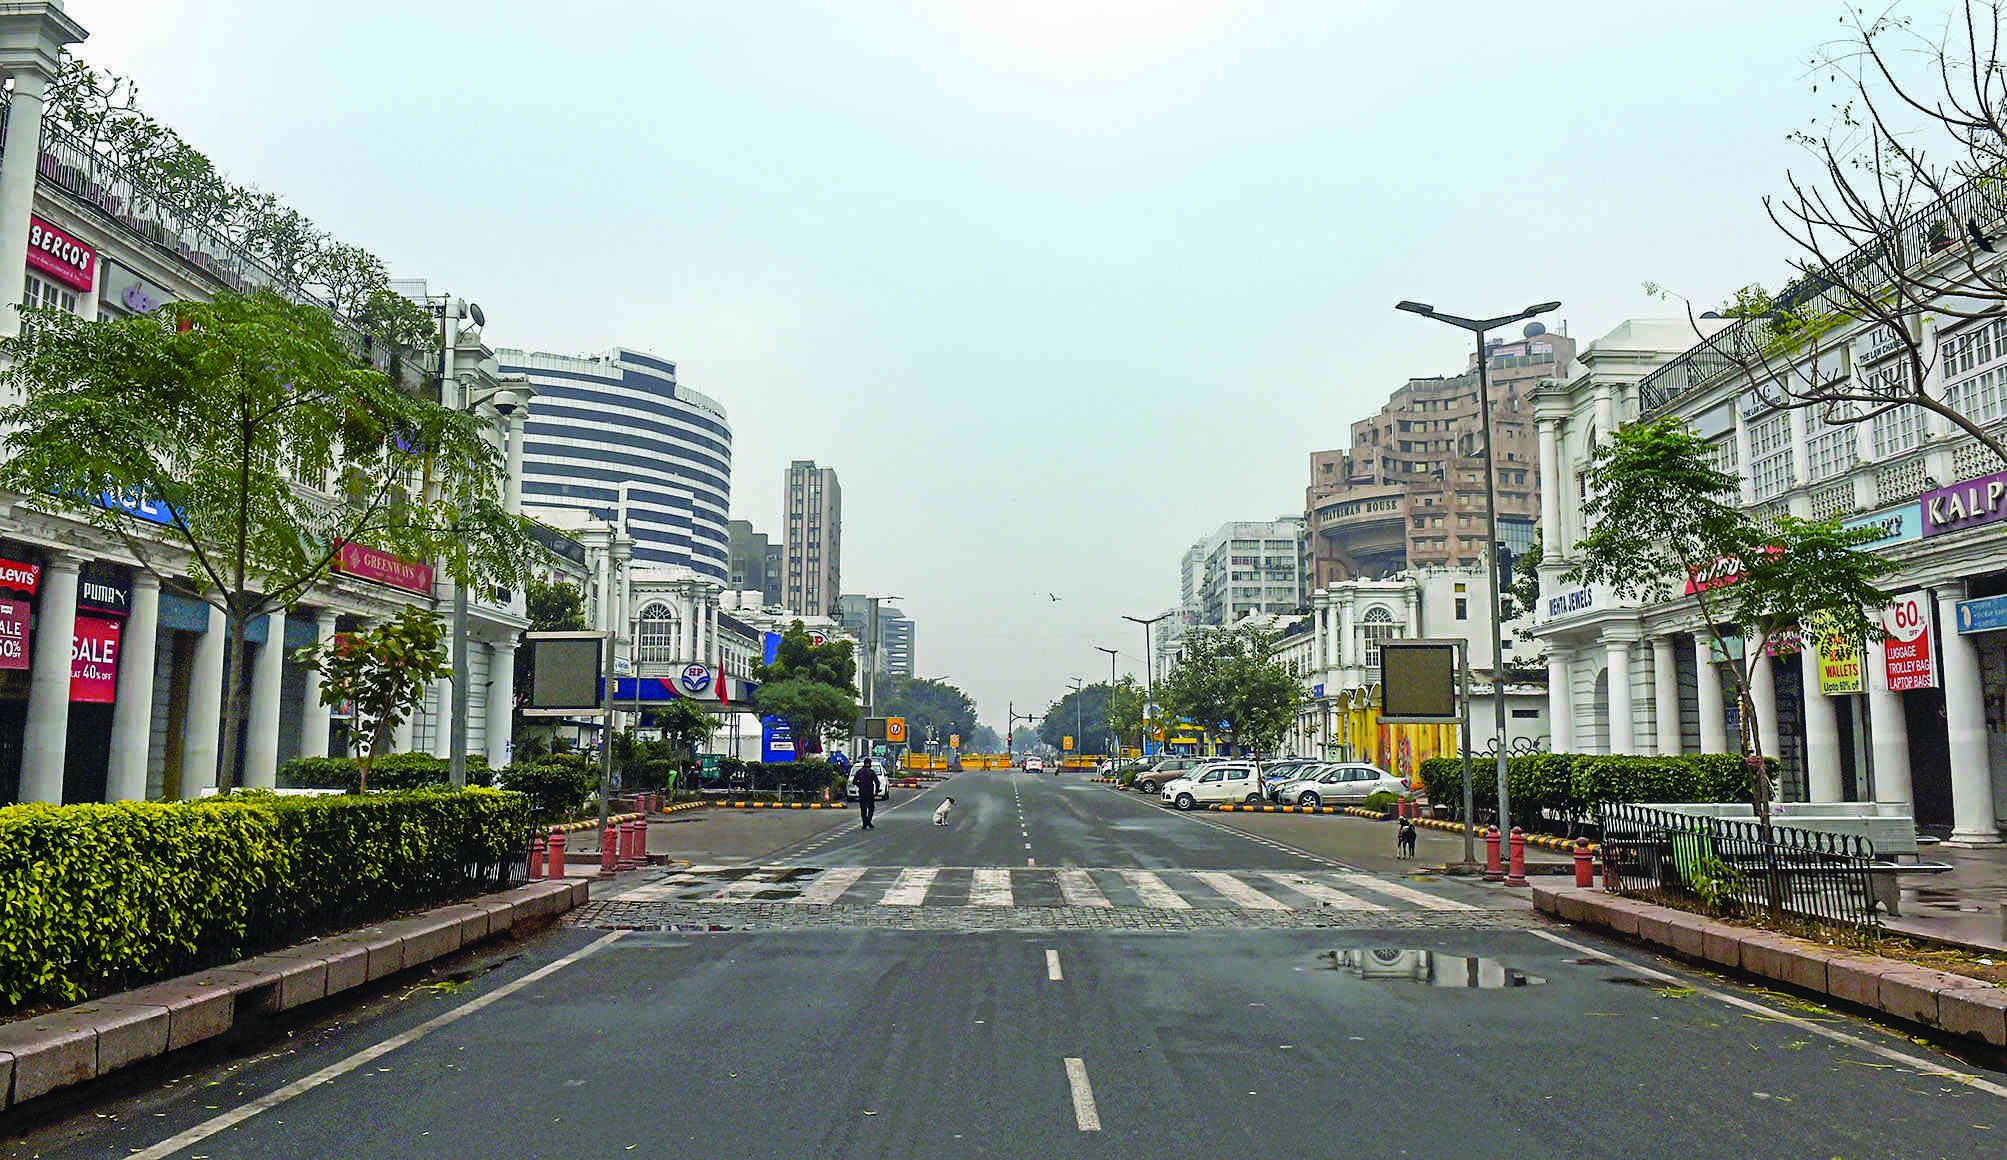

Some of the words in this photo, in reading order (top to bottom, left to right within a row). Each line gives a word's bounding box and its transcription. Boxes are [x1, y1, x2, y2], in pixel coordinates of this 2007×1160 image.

[30, 225, 90, 270] BERCO'S
[1366, 500, 1398, 513] HOUSE
[1929, 481, 2007, 527] KALP
[363, 552, 416, 577] GREENWAYS
[83, 582, 115, 604] PUMA
[1548, 596, 1568, 617] MEHTA
[1569, 587, 1593, 612] JEWELS
[0, 620, 22, 636] ALE
[0, 640, 21, 658] 0%
[1887, 645, 1917, 660] LUGGAGE
[83, 664, 101, 680] 40%
[688, 668, 704, 676] HP
[1825, 664, 1859, 678] WALLETS
[1888, 661, 1915, 675] TROLLEY
[1889, 676, 1914, 689] LAPTOP
[1915, 675, 1931, 687] BAGS
